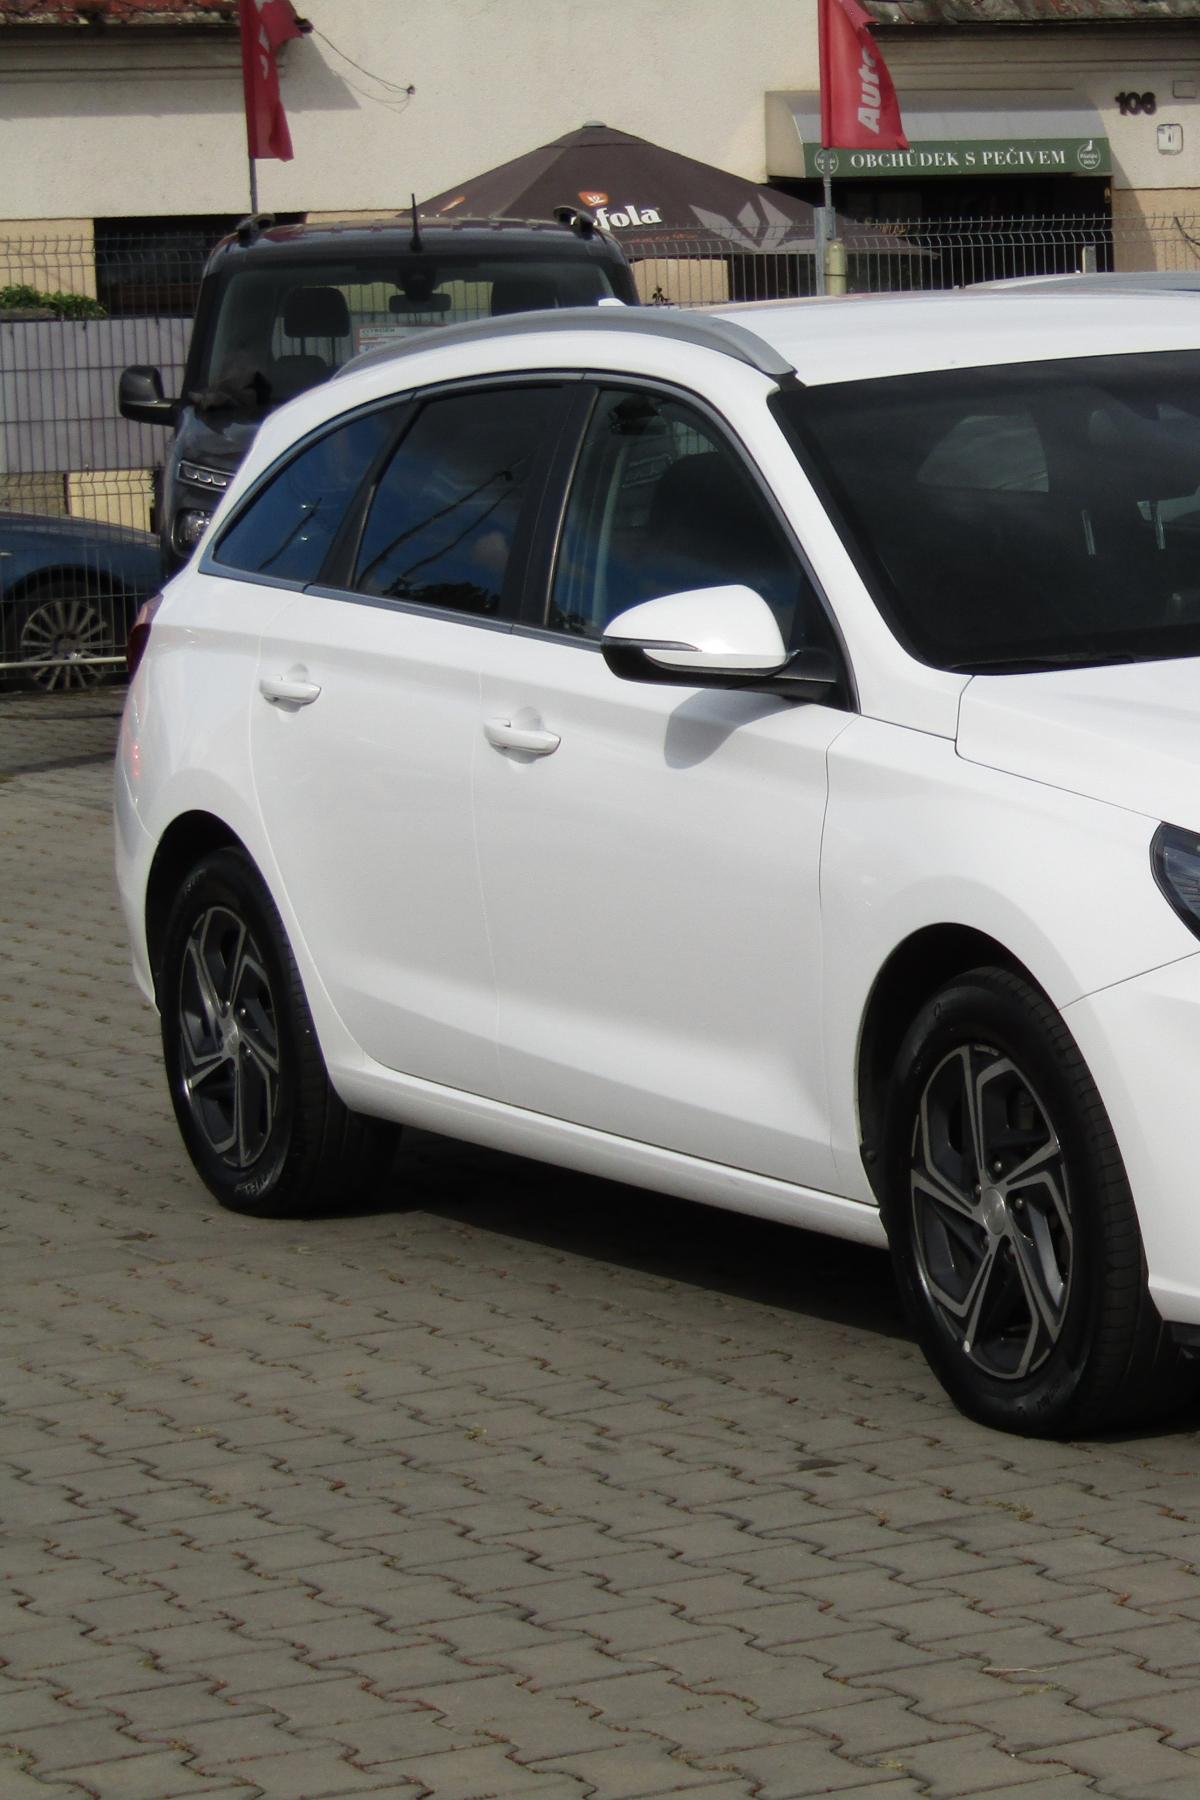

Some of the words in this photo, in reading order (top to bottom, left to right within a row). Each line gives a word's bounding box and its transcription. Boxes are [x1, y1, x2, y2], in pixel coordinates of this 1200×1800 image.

[850, 148, 960, 168] OBCHŮDEK
[965, 151, 976, 166] S
[982, 147, 1066, 166] PEČIVEM
[570, 204, 662, 232] fola
